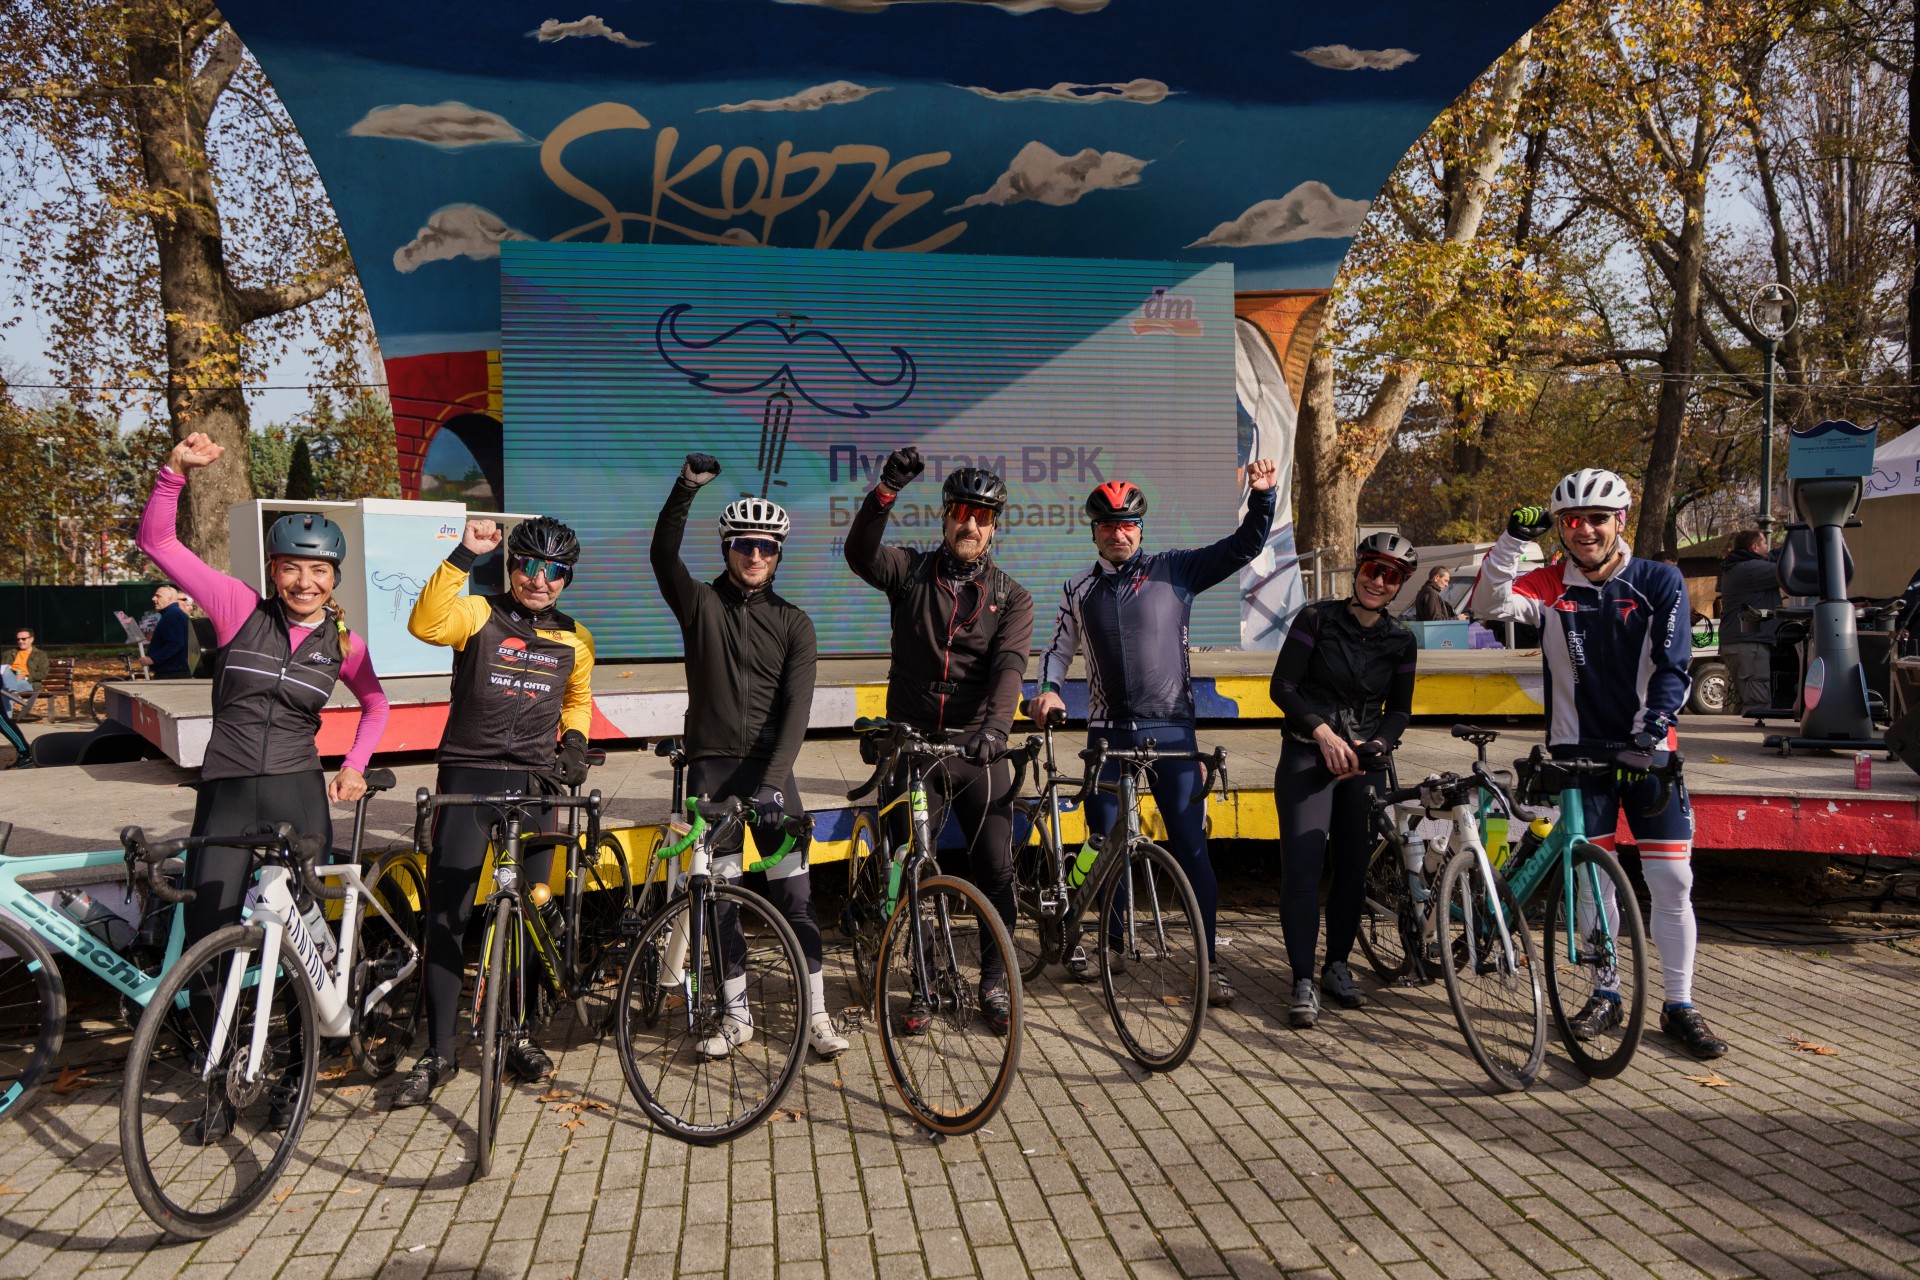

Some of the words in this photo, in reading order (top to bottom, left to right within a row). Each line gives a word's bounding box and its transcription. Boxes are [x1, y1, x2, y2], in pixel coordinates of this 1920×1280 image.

[1144, 290, 1193, 319] dm
[1022, 446, 1106, 483] БРК
[440, 524, 456, 534] dm
[498, 647, 515, 656] DE
[1575, 630, 1586, 665] Team
[490, 676, 511, 687] VAN
[1508, 840, 1552, 900] anchi
[10, 893, 149, 990] Bianchi
[285, 904, 325, 991] CANYON
